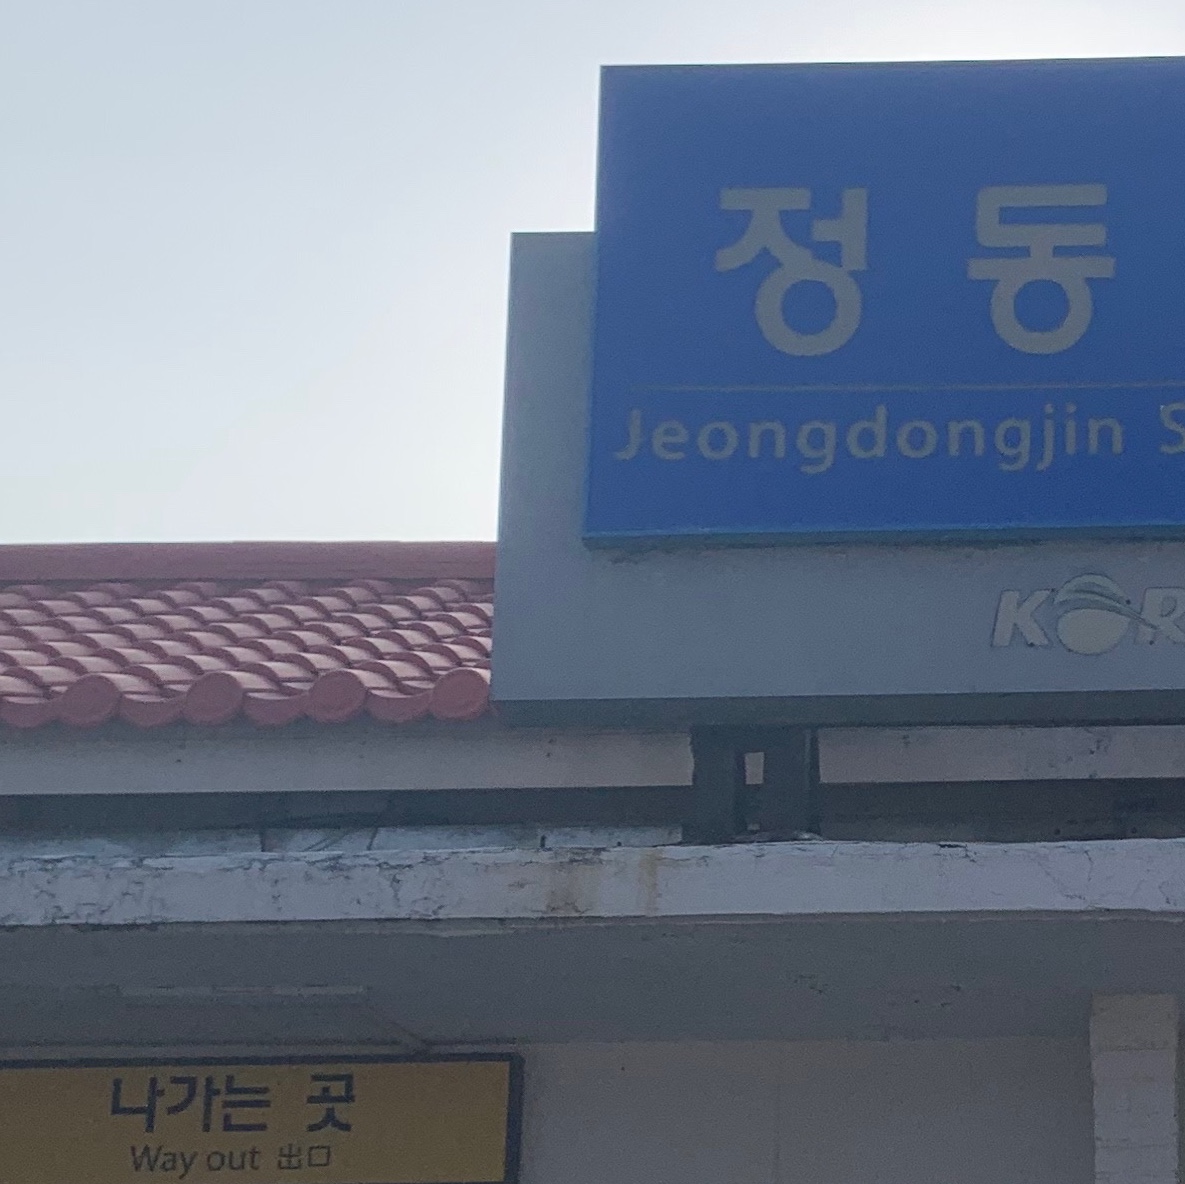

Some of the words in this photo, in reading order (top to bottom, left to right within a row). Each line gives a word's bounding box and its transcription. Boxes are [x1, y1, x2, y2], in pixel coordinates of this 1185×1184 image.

[613, 402, 1125, 475] Jeongdongjin
[110, 1074, 272, 1133] 나가는
[306, 1073, 356, 1133] 곳
[130, 1144, 197, 1180] Way
[206, 1147, 261, 1171] out
[276, 1142, 333, 1171] 出口
